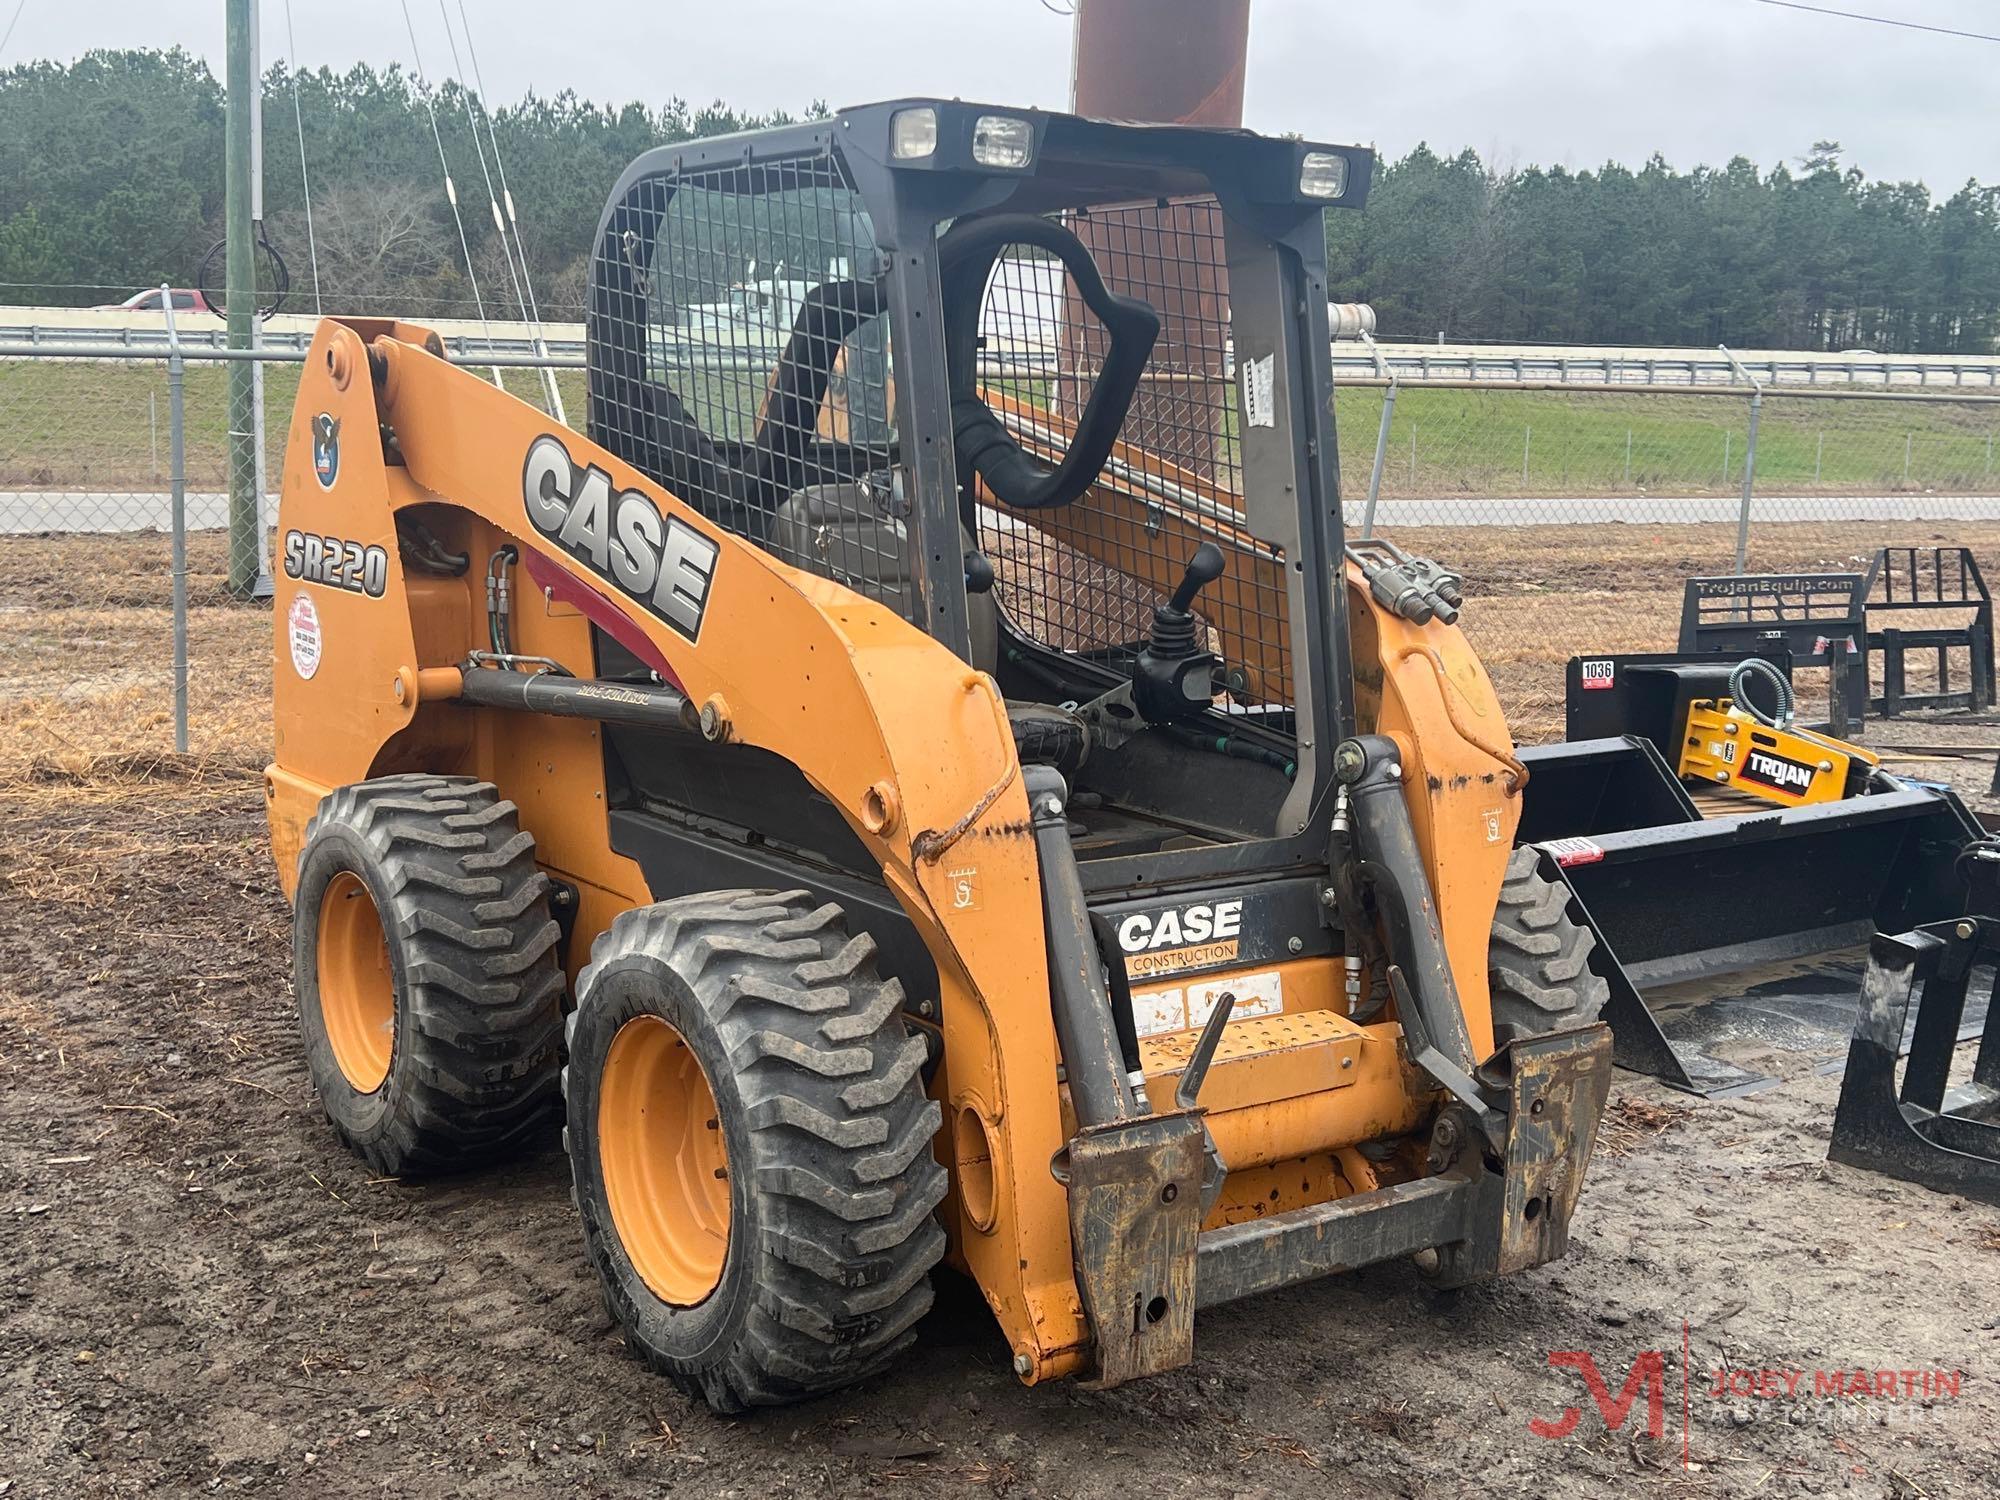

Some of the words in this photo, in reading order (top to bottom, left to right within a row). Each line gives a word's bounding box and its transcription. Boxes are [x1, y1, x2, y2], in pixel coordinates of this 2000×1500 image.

[523, 435, 719, 638] CASE
[284, 530, 388, 597] SR220
[1696, 579, 1853, 595] TrojanEquip.com
[1585, 663, 1611, 678] 1036
[1750, 753, 1812, 787] TROJAN
[1119, 900, 1243, 952] CASE
[1133, 944, 1234, 971] CONSTRUCTION
